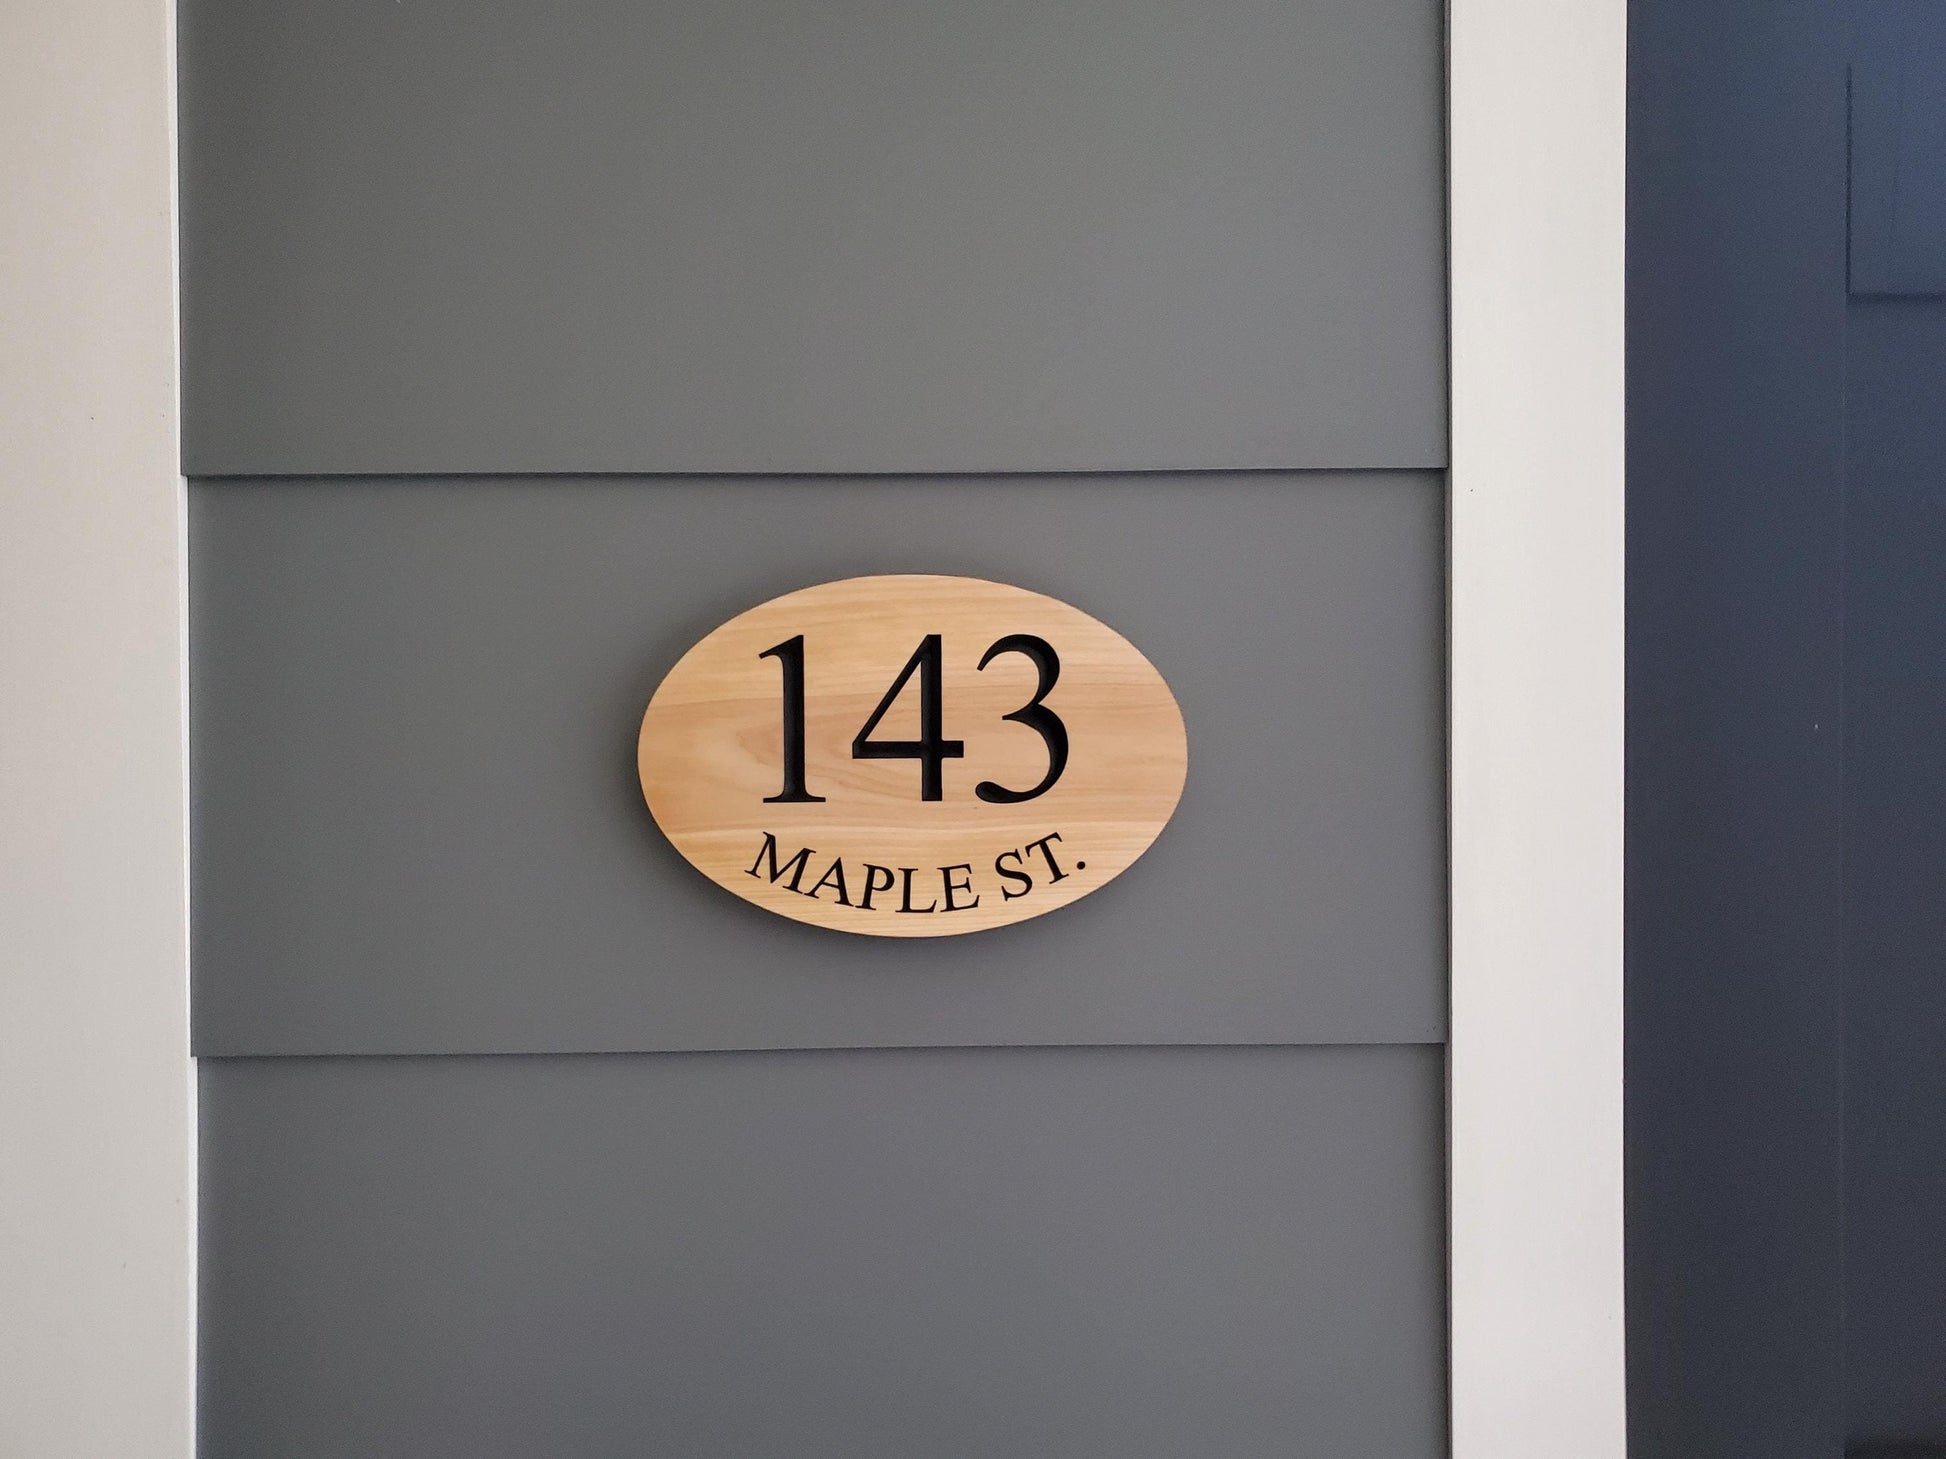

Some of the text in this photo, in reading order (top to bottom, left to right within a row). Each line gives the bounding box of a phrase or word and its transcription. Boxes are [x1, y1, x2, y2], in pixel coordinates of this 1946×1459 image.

[758, 633, 1069, 804] 143
[744, 831, 1087, 913] MAPLE ST.
